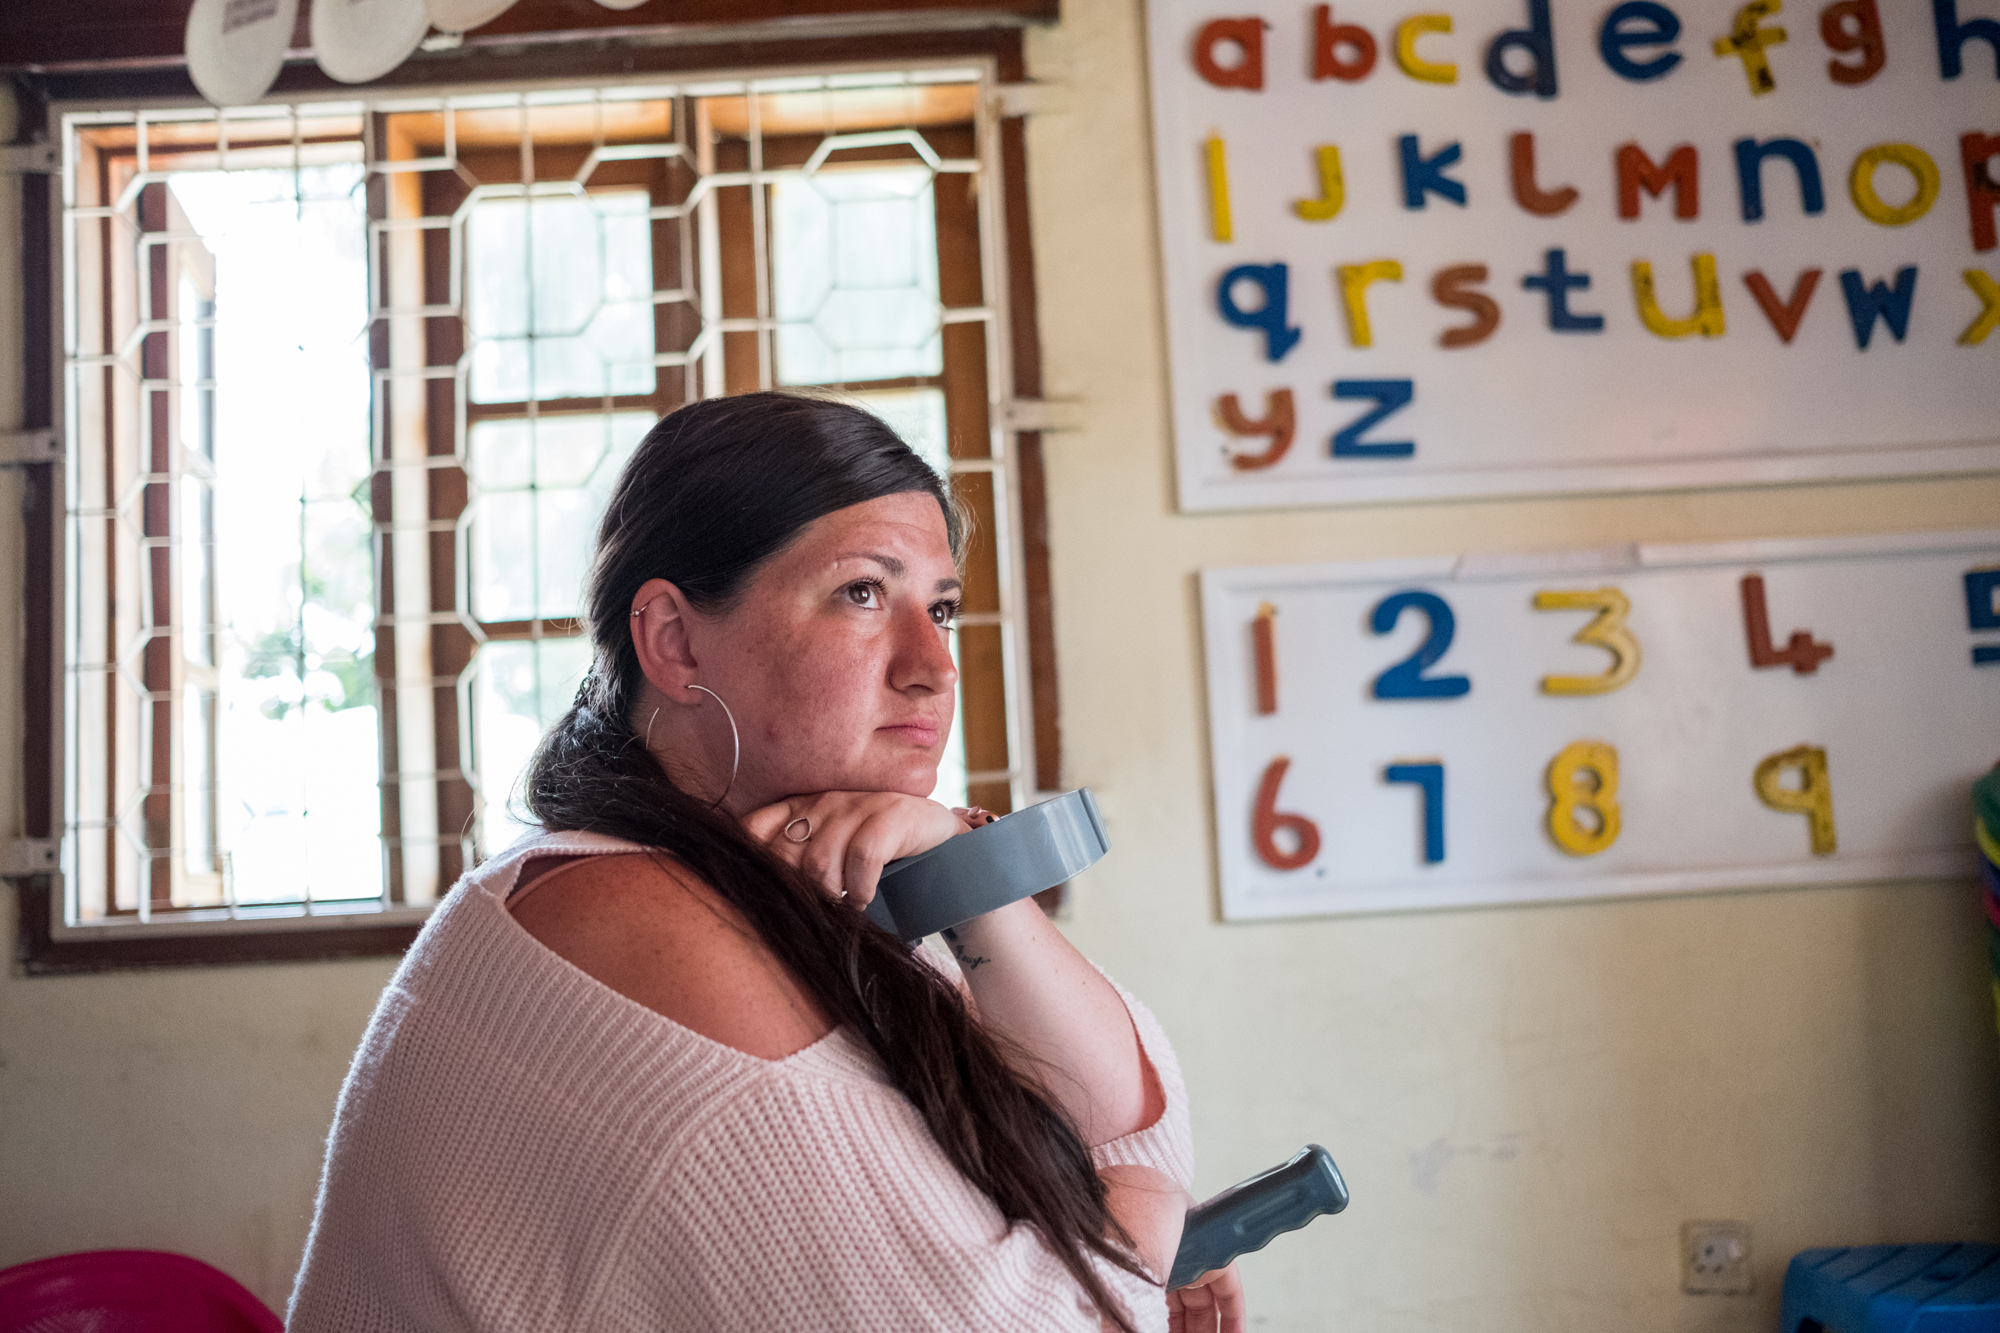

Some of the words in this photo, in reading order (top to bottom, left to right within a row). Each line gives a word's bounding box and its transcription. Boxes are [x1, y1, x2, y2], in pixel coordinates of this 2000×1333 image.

[1193, 17, 1266, 91] a
[1310, 5, 1378, 82] b
[1486, 0, 1559, 98] d
[1601, 1, 1683, 82] e
[1713, 0, 1787, 95] f
[1819, 0, 1887, 86] g
[1932, 0, 2000, 80] h
[1616, 143, 1699, 220] M
[1735, 138, 1826, 222] n
[1218, 262, 1302, 361] q
[1337, 260, 1404, 347] r
[1523, 248, 1605, 332] t
[1632, 253, 1726, 338] u
[1214, 388, 1296, 471] y
[1370, 589, 1471, 699] 2
[1533, 588, 1640, 695] 3
[1741, 573, 1834, 674] 4
[1252, 756, 1321, 871] 6
[1383, 760, 1445, 864] 7
[1545, 741, 1622, 856] 8
[1753, 745, 1837, 856] 9
